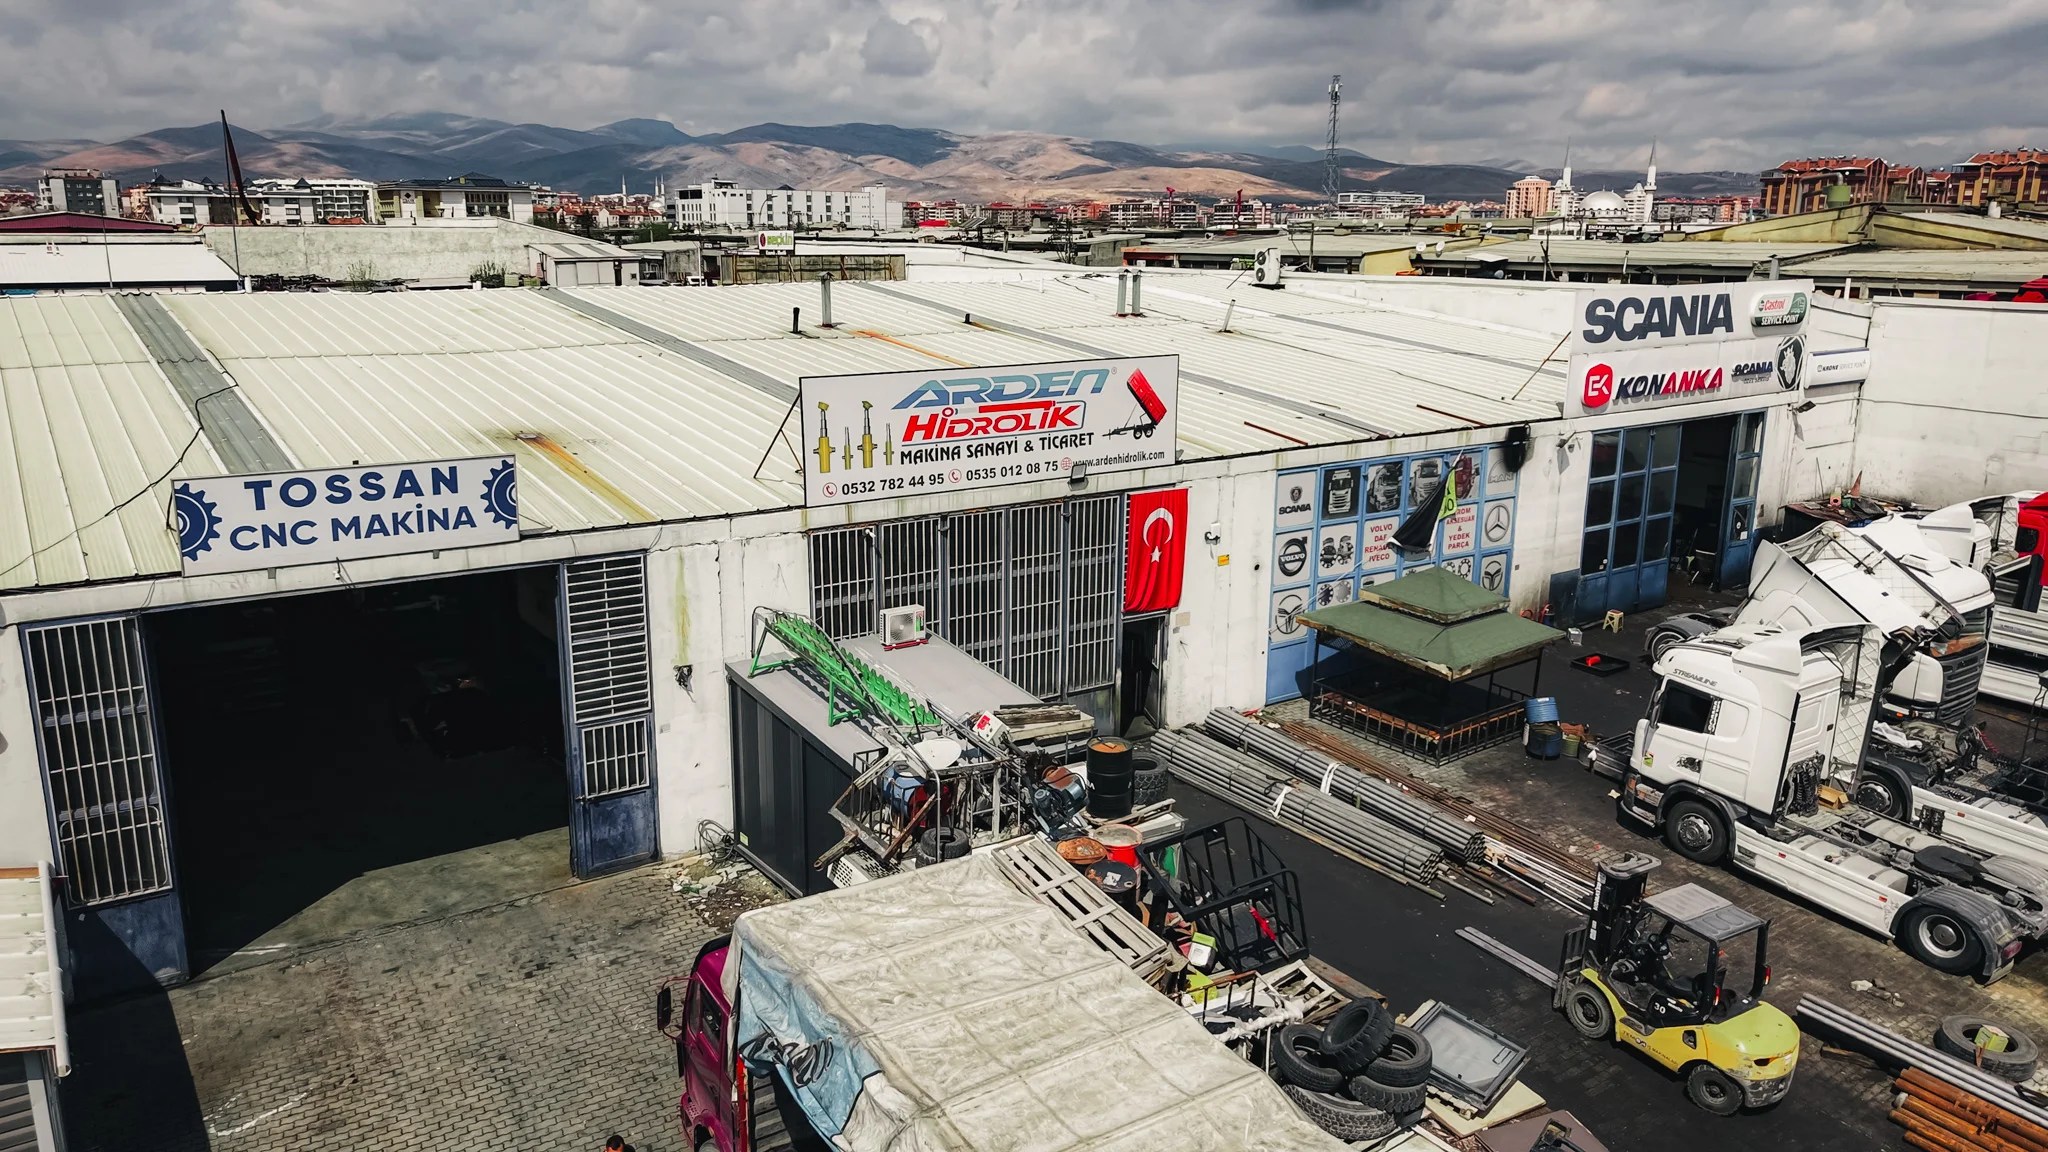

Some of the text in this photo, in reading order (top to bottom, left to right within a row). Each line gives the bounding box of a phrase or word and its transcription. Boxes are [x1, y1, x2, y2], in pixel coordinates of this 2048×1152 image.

[1764, 299, 1786, 311] Castrol
[1583, 293, 1734, 344] SCANIA
[1760, 313, 1800, 326] SERVICE POINT
[1732, 361, 1774, 376] SCANIA
[891, 368, 1110, 410] ARDEN
[1615, 366, 1723, 400] KONANKA
[902, 400, 1081, 442] HİDROLİK
[900, 431, 1095, 466] MAKİNA SANAYİ & TİCARET
[841, 460, 1059, 496] 0532 782 44 95 0535 012 08 75
[1489, 473, 1513, 482] MAN
[244, 466, 459, 511] TOSSAN
[1279, 503, 1311, 515] SCANIA
[1455, 507, 1471, 516] ROM
[1446, 514, 1475, 525] AKSESUAR
[229, 503, 478, 551] CNC MAKİNA
[1370, 523, 1393, 533] VOLVO
[1374, 534, 1388, 543] DAF
[1448, 532, 1470, 542] YEDEK
[1448, 541, 1469, 550] PARÇA
[1280, 552, 1305, 562] VOLVO
[1368, 552, 1390, 562] IVECO
[1672, 668, 1717, 687] STREAMLINE
[1654, 1002, 1666, 1014] 30
